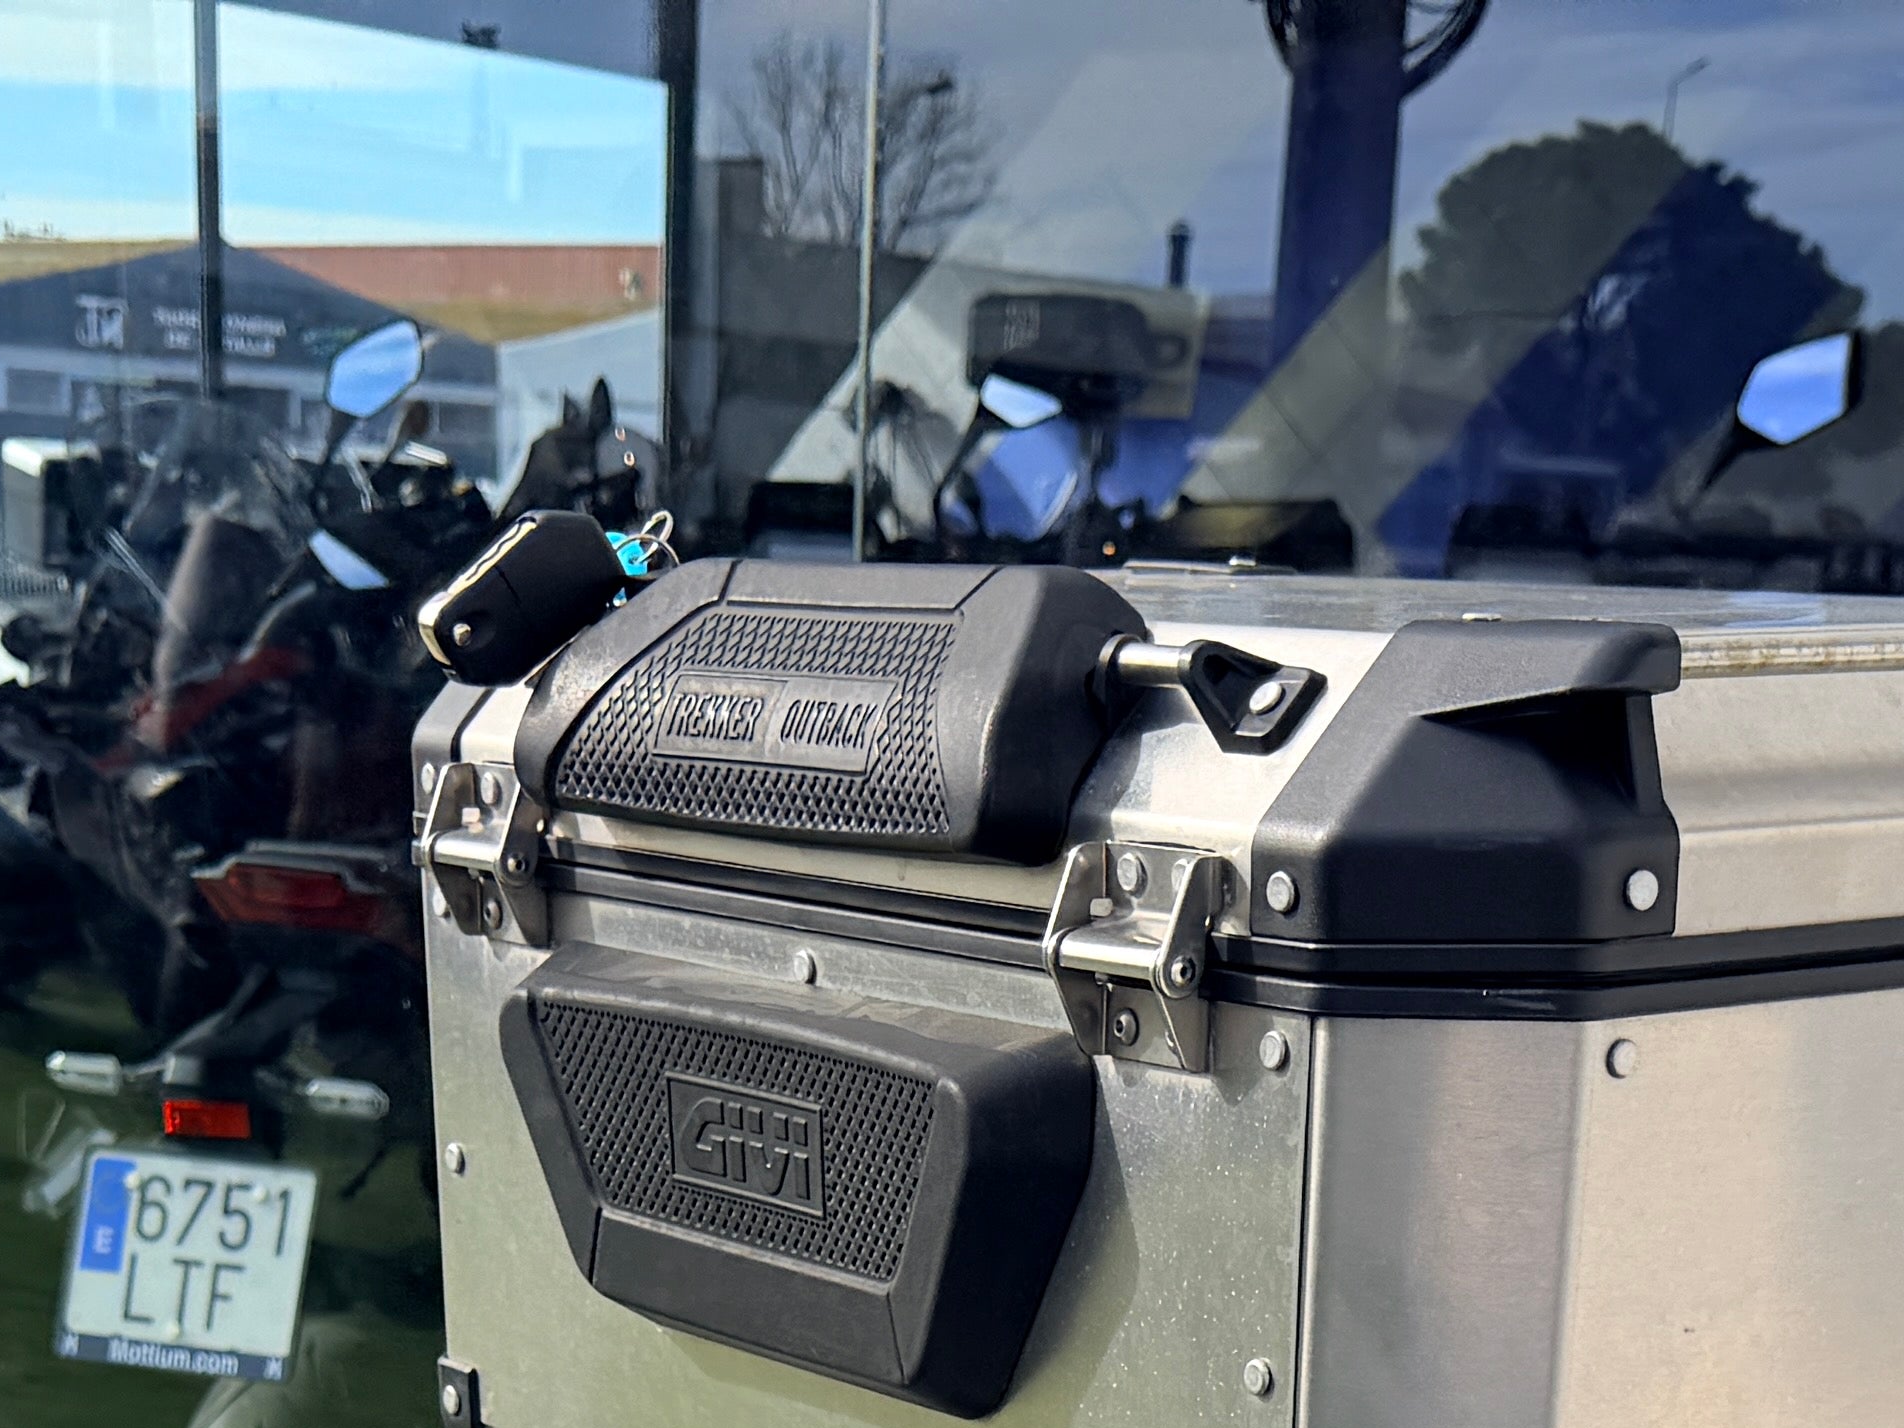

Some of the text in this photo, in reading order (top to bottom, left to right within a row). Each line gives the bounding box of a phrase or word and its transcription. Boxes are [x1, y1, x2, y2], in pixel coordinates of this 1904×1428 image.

[666, 693, 878, 749] TREKKER OUTBACK
[680, 1097, 811, 1201] GIVI
[136, 1175, 292, 1259] 6751
[123, 1251, 246, 1339] LTF
[106, 1337, 240, 1376] Mottium.com
